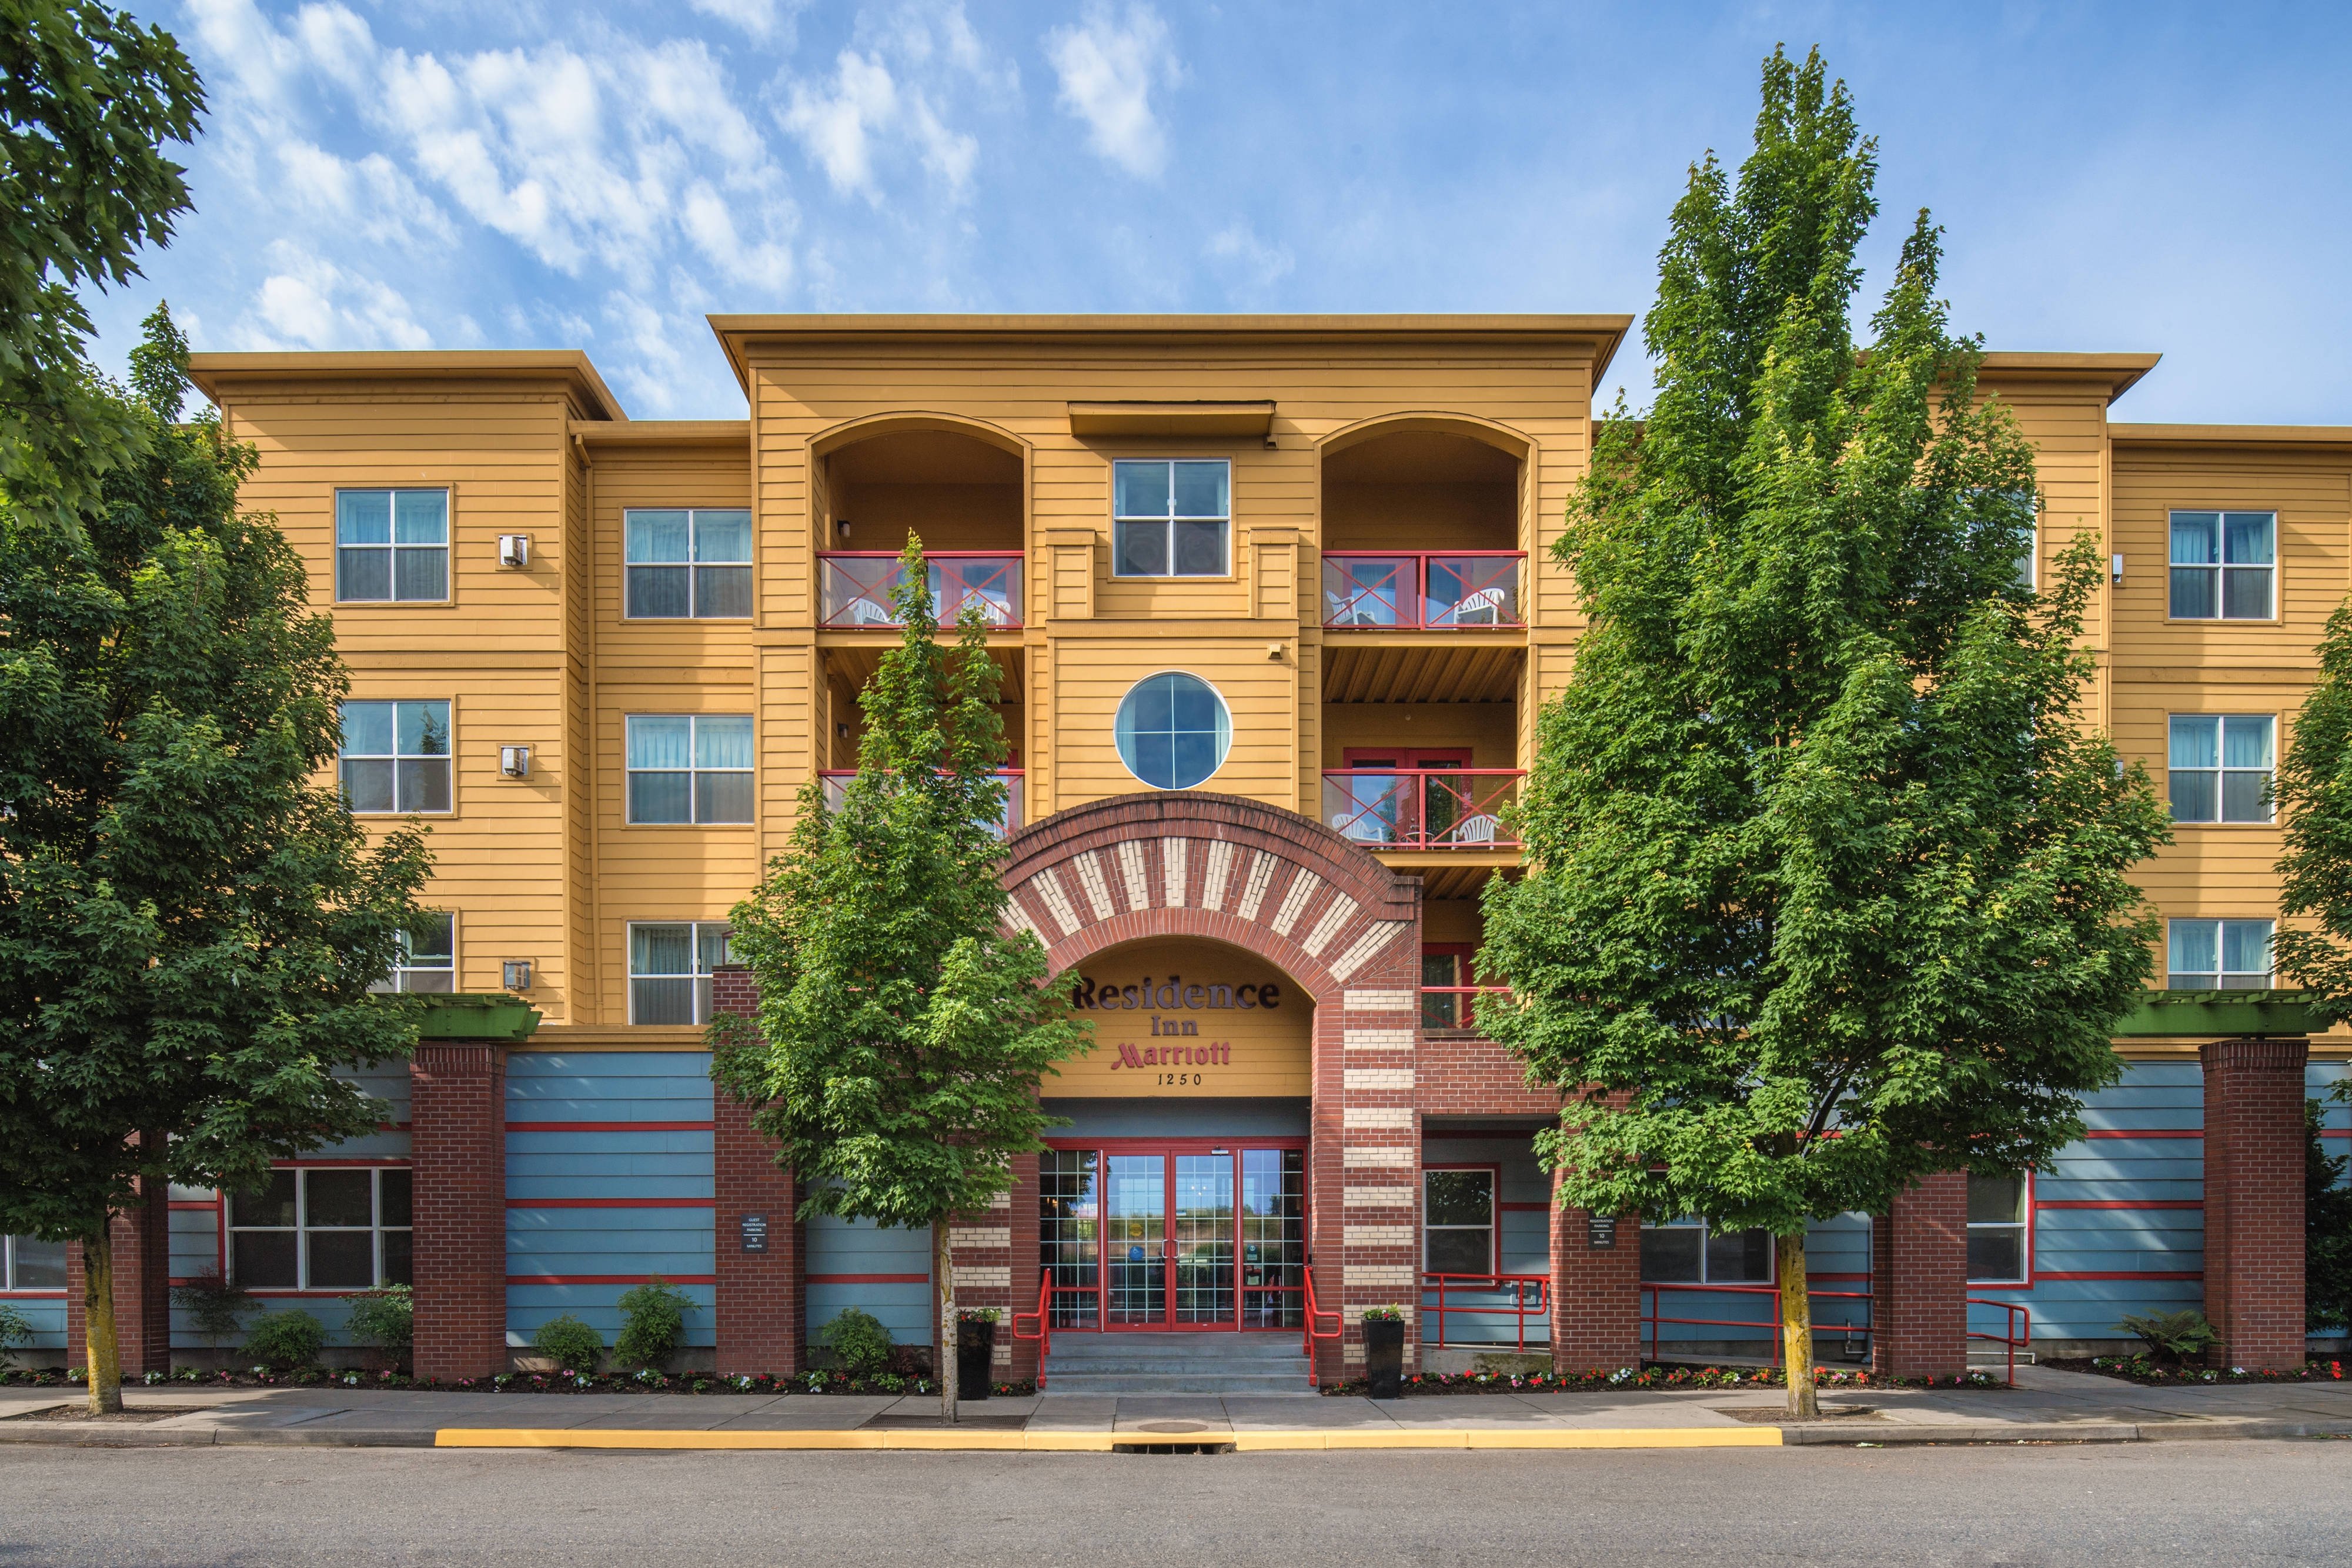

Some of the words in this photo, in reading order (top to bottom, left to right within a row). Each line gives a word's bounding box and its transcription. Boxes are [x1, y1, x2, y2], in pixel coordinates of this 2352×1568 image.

[1073, 976, 1280, 1010] Residence
[1151, 1015, 1199, 1036] Inn
[1111, 1042, 1231, 1069] Marriott
[1158, 1074, 1201, 1085] 1250
